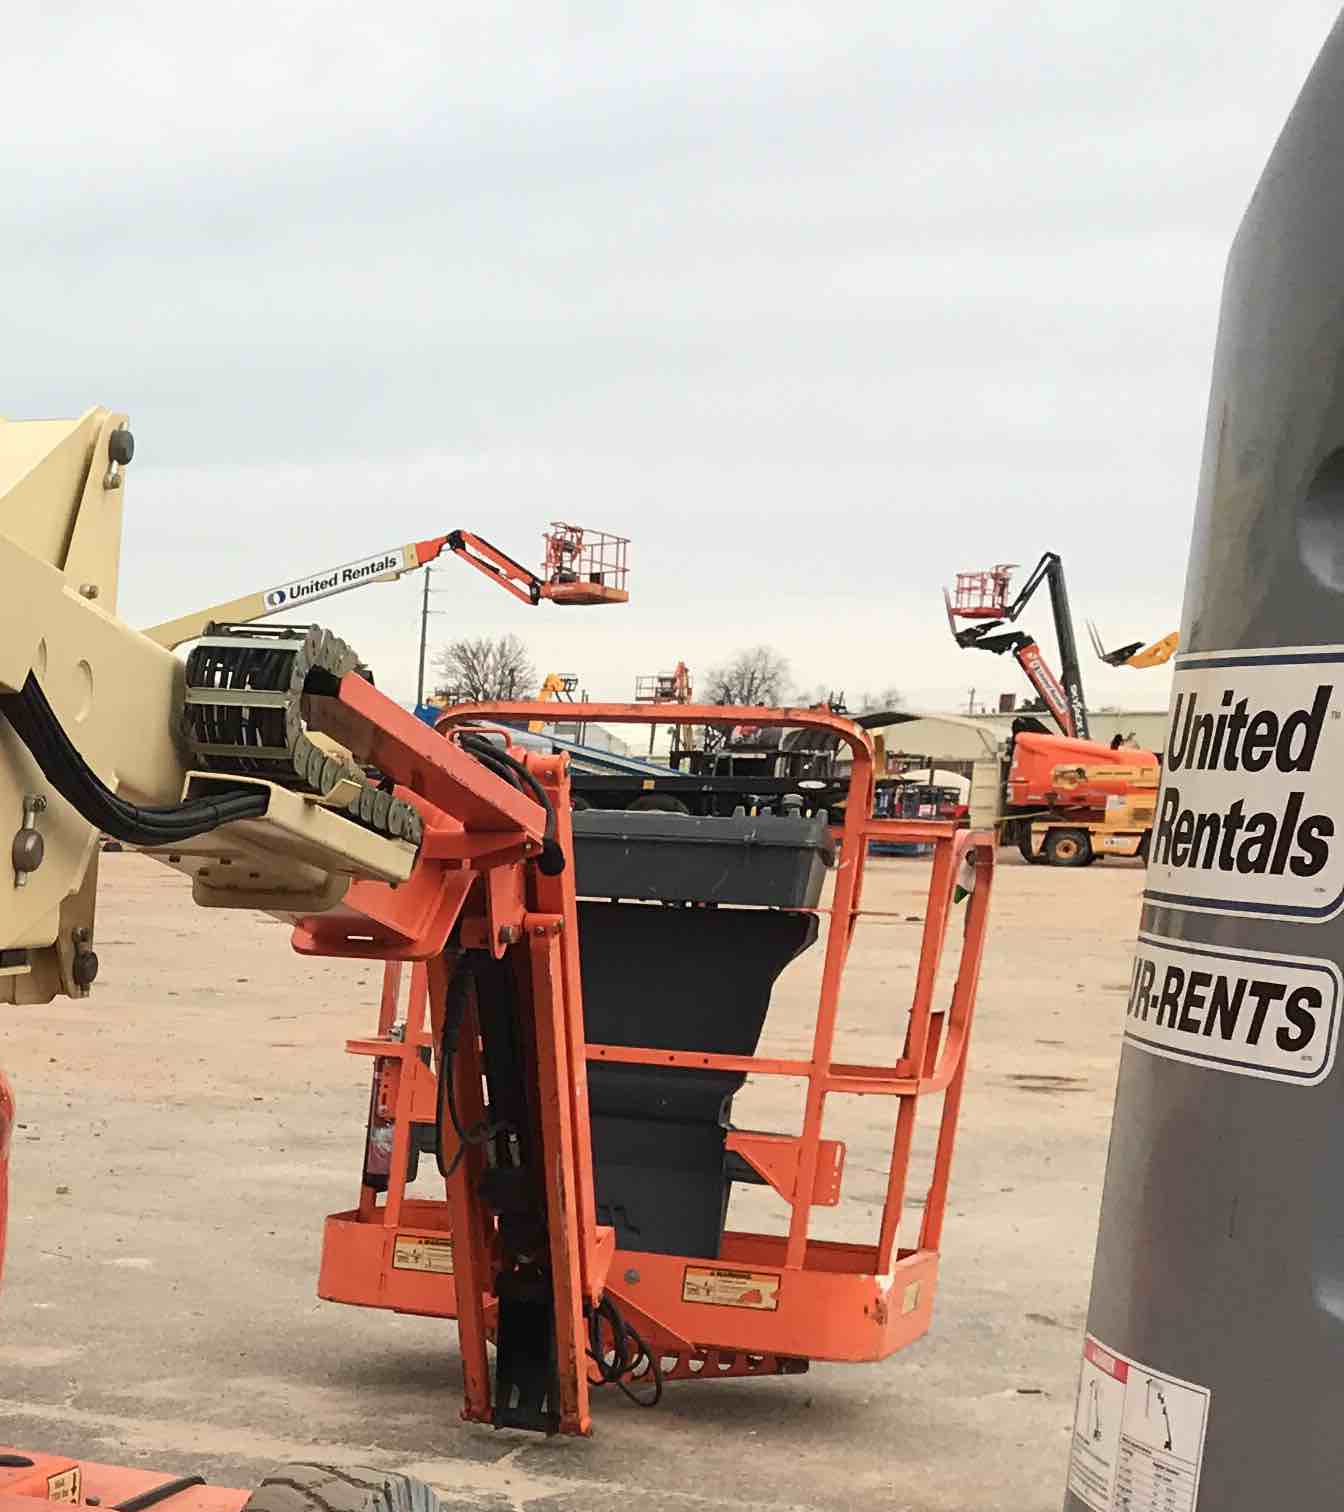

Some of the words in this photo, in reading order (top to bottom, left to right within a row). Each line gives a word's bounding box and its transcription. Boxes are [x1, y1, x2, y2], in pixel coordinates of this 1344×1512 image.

[289, 573, 338, 599] United
[342, 556, 397, 583] Rentals
[1167, 685, 1333, 773] United
[1152, 787, 1334, 877] Rentals
